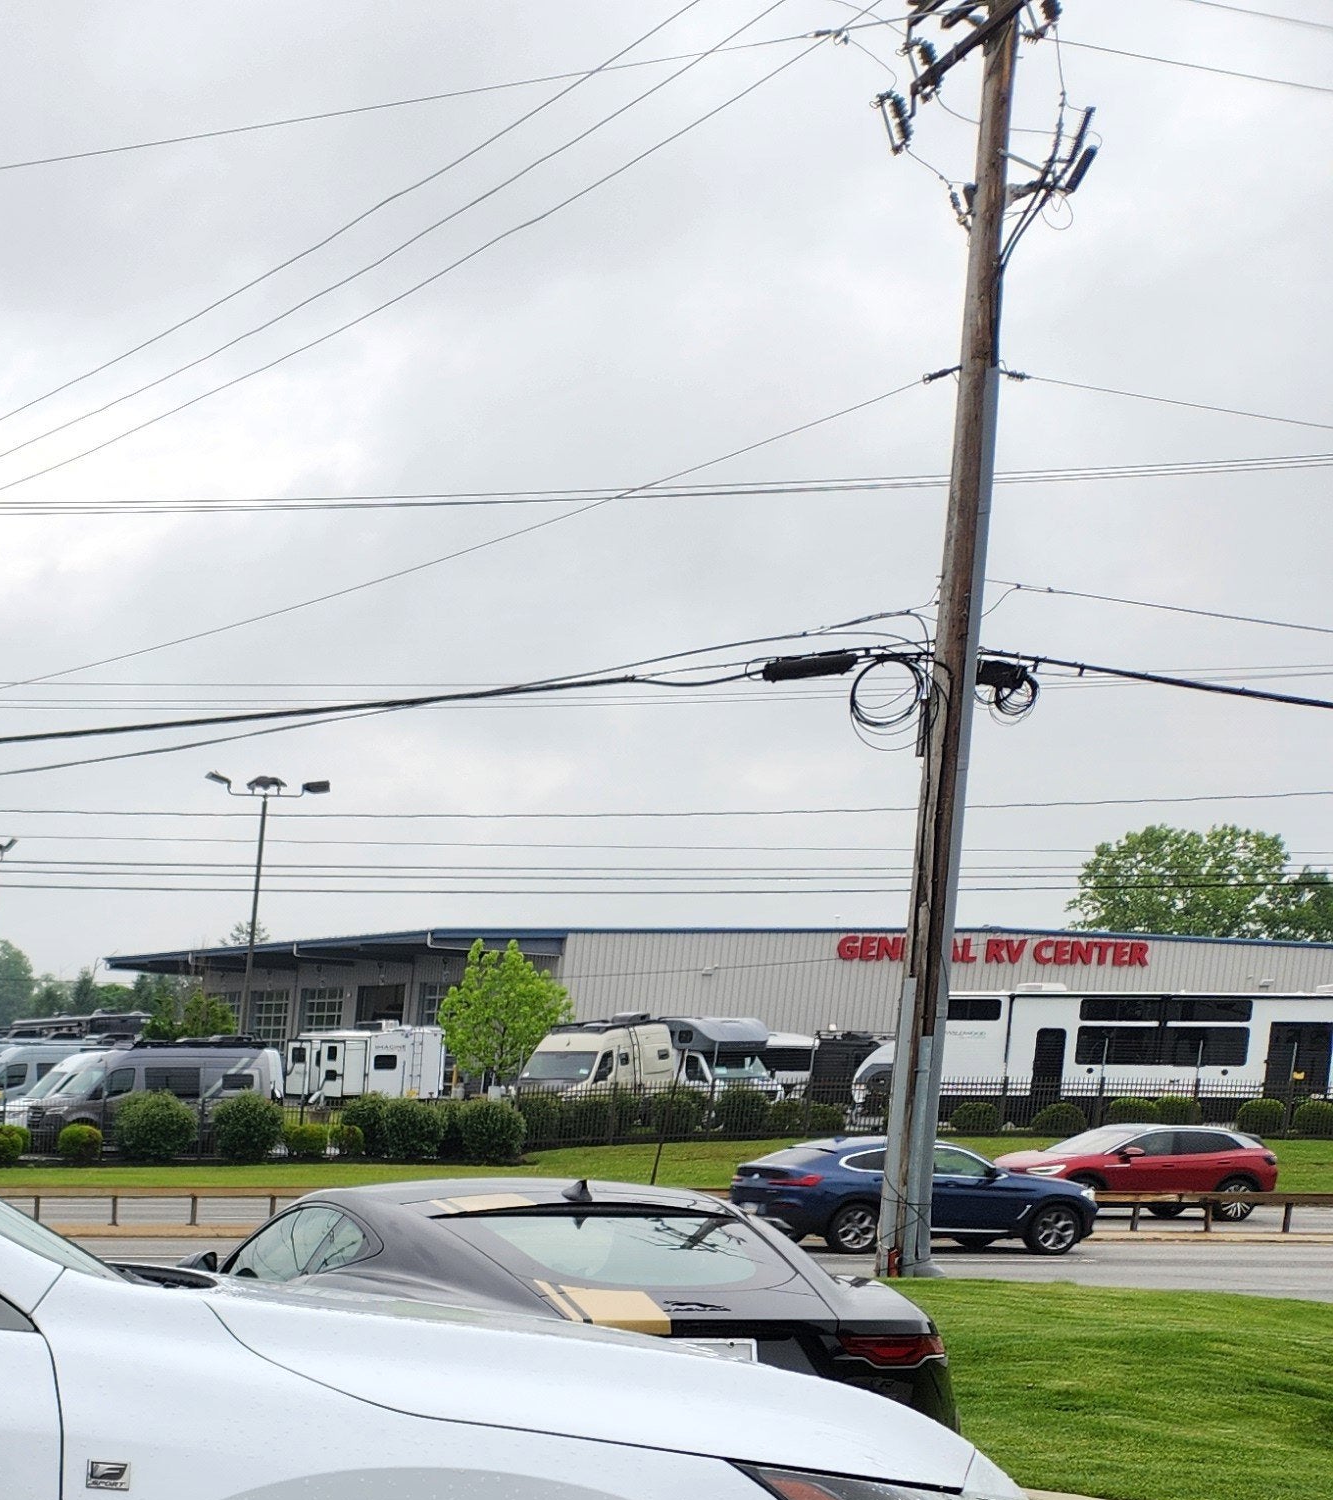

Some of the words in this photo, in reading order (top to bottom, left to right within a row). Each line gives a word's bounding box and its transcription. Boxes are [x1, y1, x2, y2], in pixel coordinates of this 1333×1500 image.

[837, 935, 977, 963] GENL
[985, 938, 1028, 965] RV
[1034, 939, 1149, 967] CENTER
